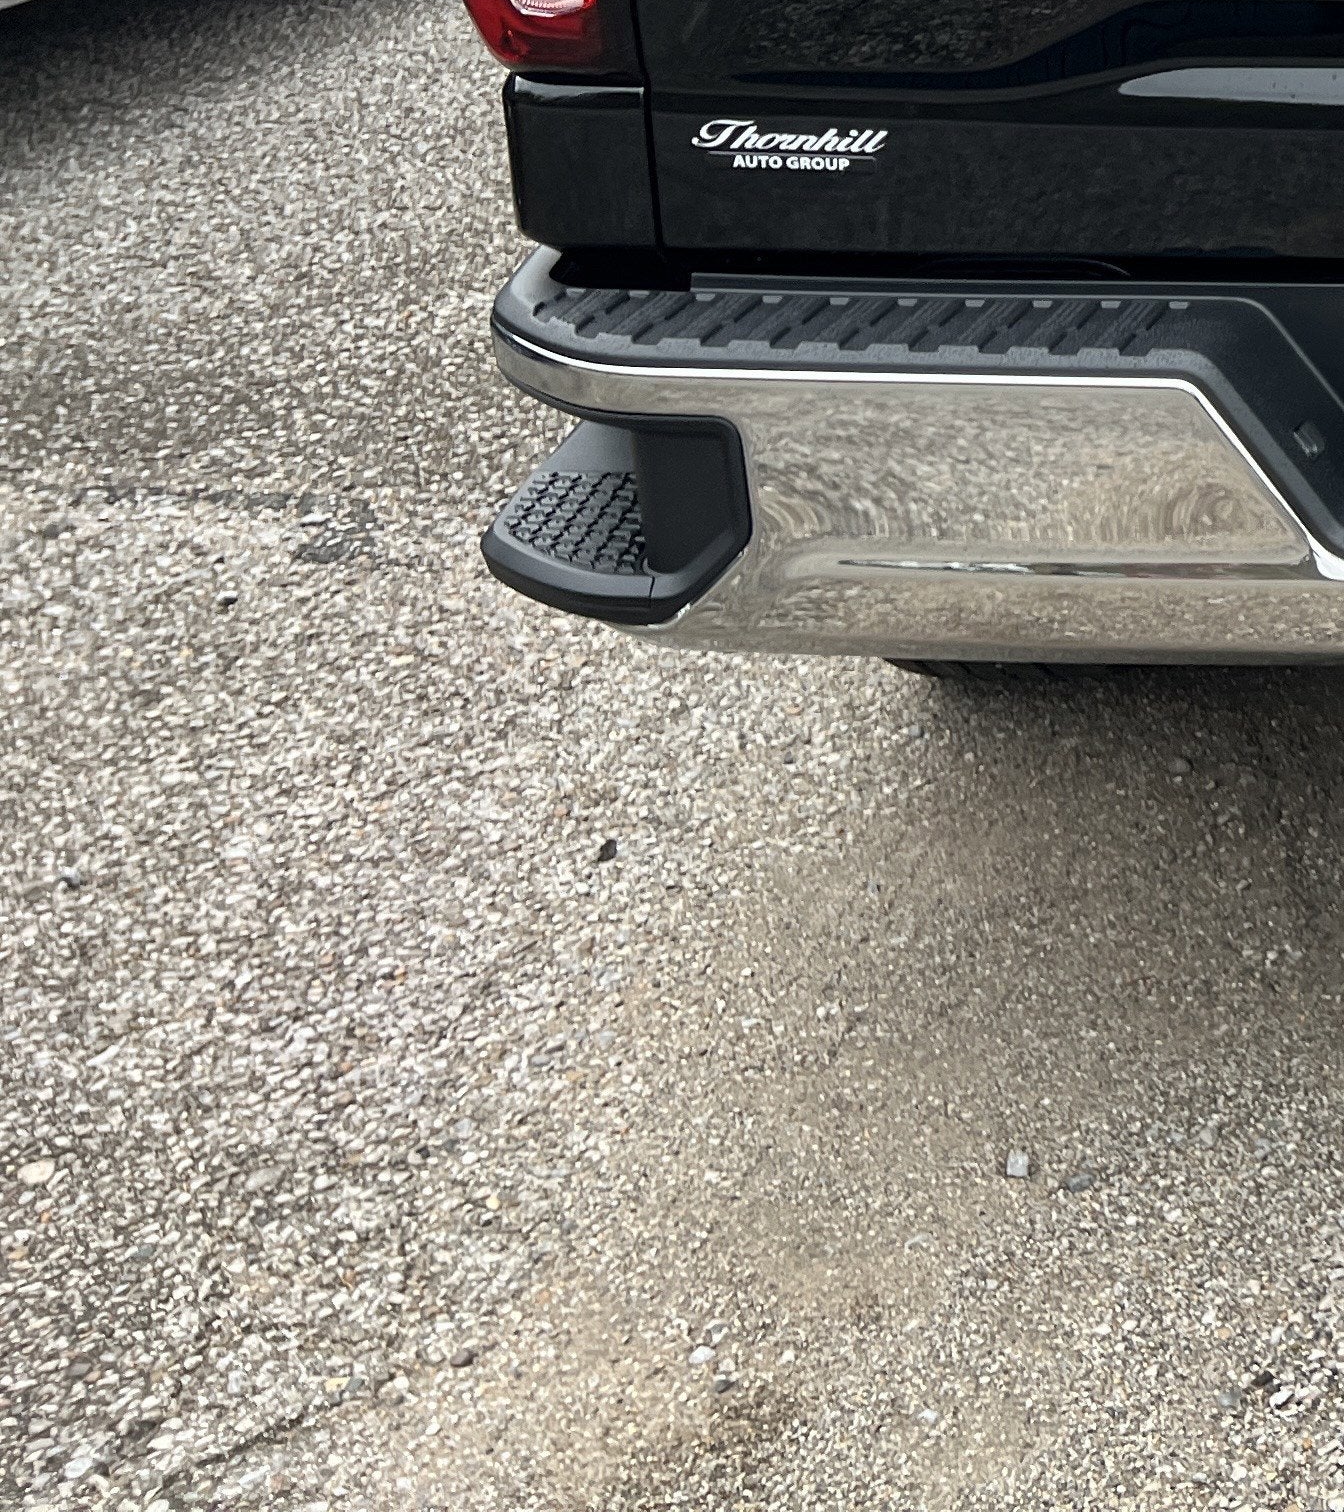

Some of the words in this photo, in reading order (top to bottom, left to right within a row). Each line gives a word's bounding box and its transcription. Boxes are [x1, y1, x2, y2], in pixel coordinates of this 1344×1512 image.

[691, 119, 889, 154] Thornhill
[733, 154, 782, 169] AUTO
[785, 156, 850, 171] GROUP
